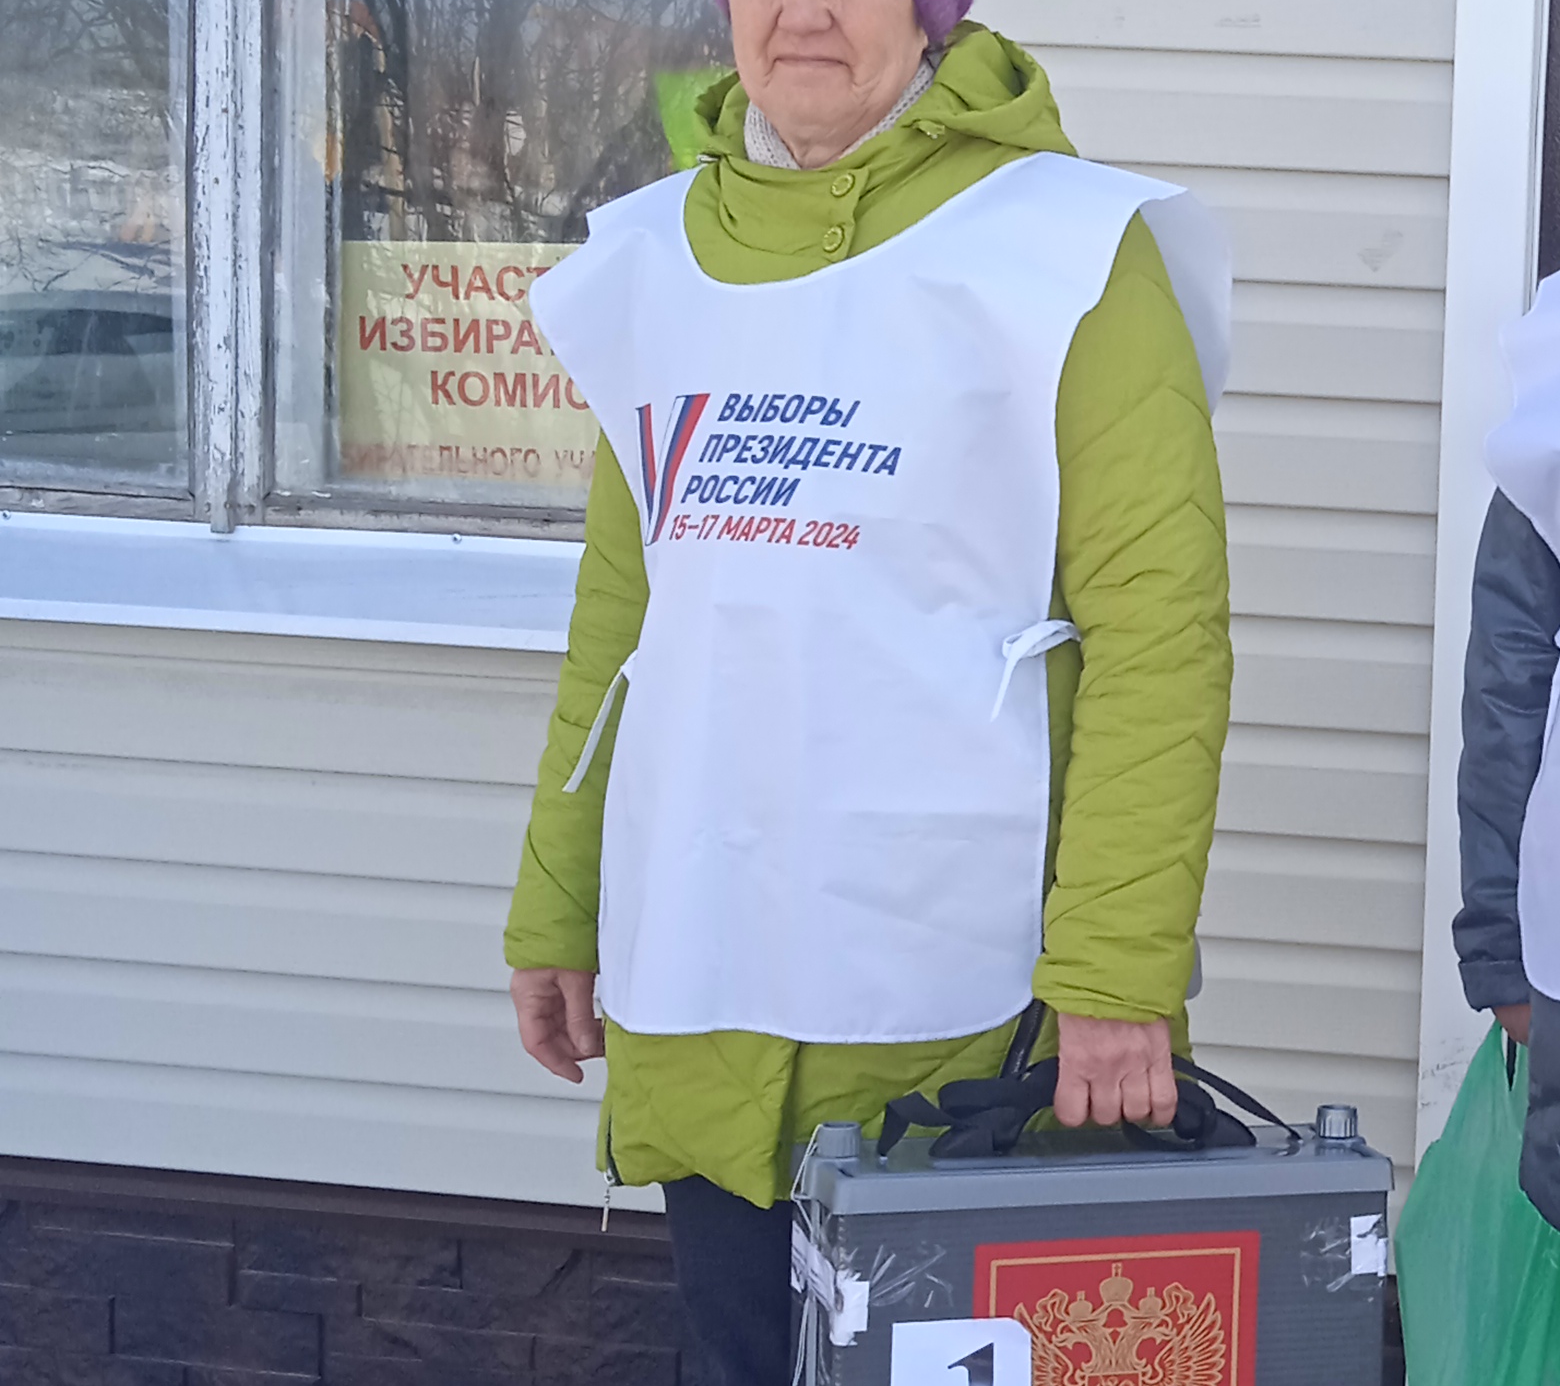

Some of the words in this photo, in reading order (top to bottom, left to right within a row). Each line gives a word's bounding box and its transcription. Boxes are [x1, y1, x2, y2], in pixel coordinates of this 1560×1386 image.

[358, 315, 556, 357] ИЗБИРА
[717, 393, 861, 428] ВЫБОРЫ
[699, 433, 902, 476] ПРЕЗИДЕНТА
[681, 475, 801, 507] РОССИИ
[716, 515, 797, 545] МАРТА
[797, 519, 861, 551] 2024
